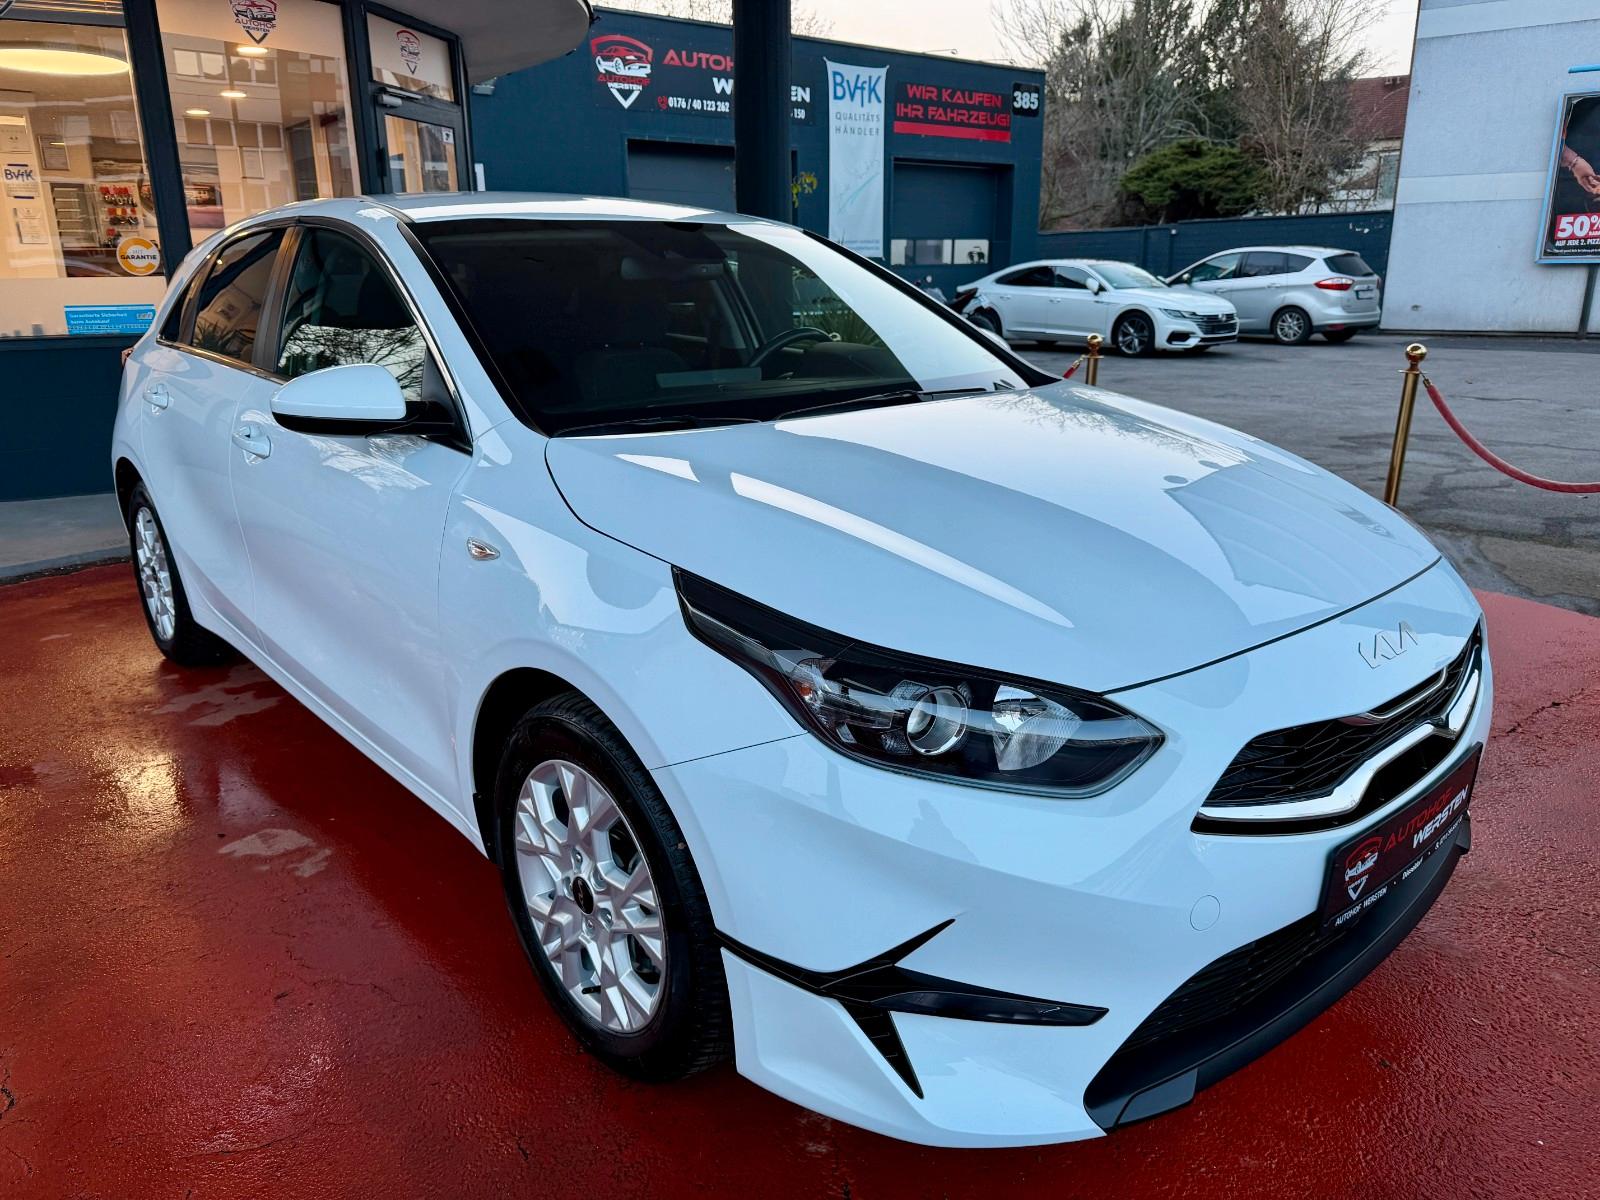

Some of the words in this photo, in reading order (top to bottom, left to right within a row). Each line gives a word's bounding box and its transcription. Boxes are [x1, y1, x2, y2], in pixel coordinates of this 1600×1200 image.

[832, 70, 883, 108] BVfK
[906, 83, 938, 100] WIR
[941, 88, 1003, 108] KAUFEN
[668, 97, 686, 109] 0176
[692, 99, 702, 110] 40
[703, 100, 716, 112] 123
[716, 101, 730, 113] 262
[1013, 90, 1039, 110] 385
[834, 111, 881, 123] QUALITÄTS
[896, 102, 924, 119] IHR
[834, 126, 881, 137] HÄNDLER
[1384, 786, 1454, 853] AUTOHOF
[1413, 784, 1469, 849] WERSTEN
